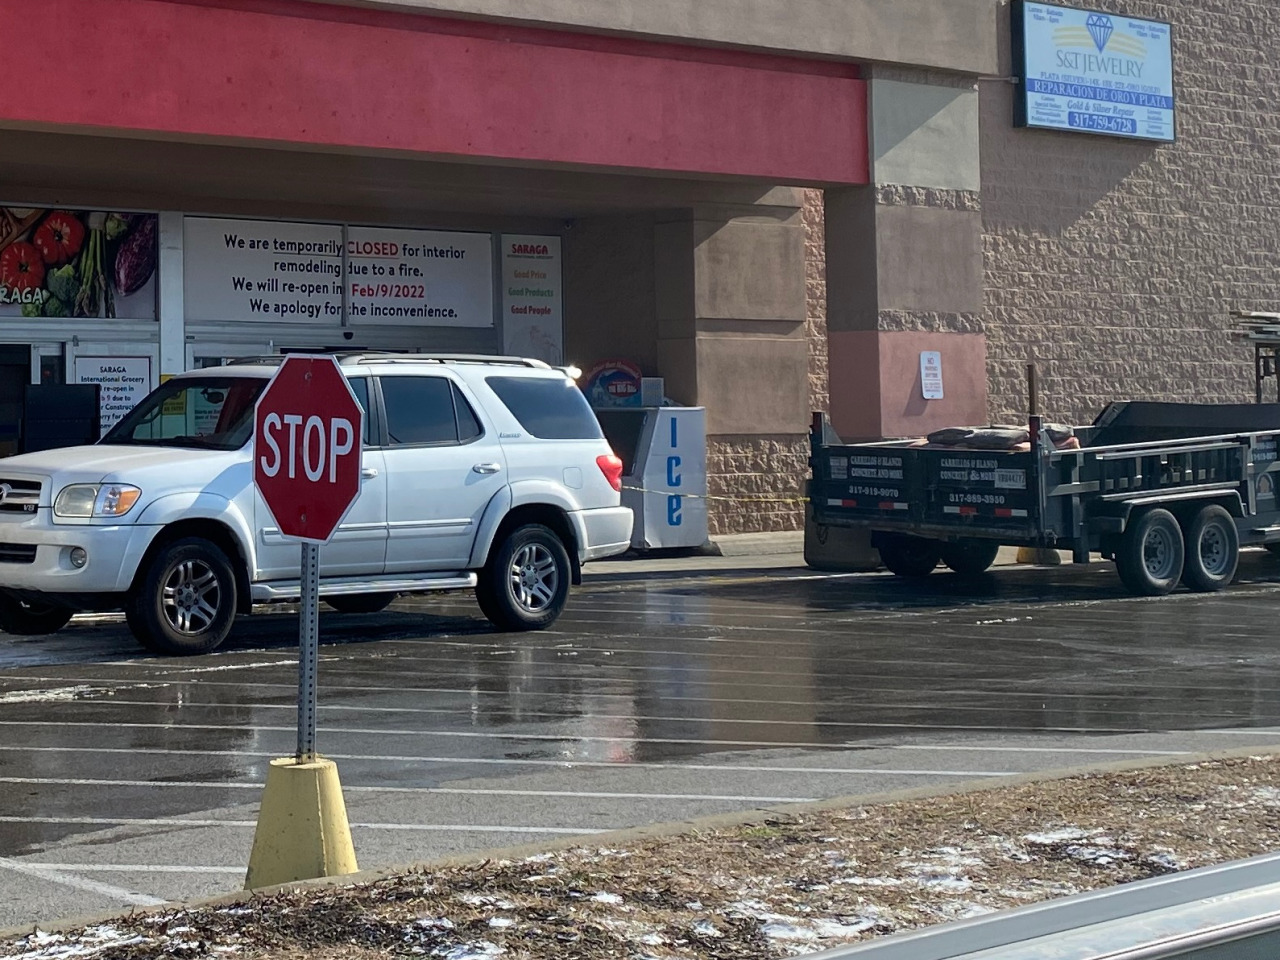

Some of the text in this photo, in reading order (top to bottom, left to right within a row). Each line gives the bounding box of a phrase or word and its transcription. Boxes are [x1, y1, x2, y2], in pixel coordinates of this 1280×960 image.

[1056, 49, 1144, 79] S&T JEWELRY
[1034, 80, 1167, 108] REPARACION DE ORO Y PLATA
[1073, 113, 1133, 133] 317-759-6728
[224, 234, 466, 259] We are temporarily CLOSED for interior
[511, 243, 548, 255] SARAGA
[274, 259, 424, 277] remodeling due to a fire.
[232, 277, 425, 298] We will re-open in Feb/9/2022
[525, 287, 554, 297] Products
[250, 298, 270, 313] We
[274, 300, 321, 318] apology
[324, 302, 341, 315] for
[371, 303, 458, 318] inconvenience.
[511, 305, 551, 317] Good People
[121, 376, 145, 384] Grocery
[261, 412, 354, 483] STOP
[851, 468, 877, 478] CONCRETE
[878, 469, 889, 478] AND
[940, 471, 969, 480] CONCRETE
[970, 470, 980, 481] &
[23, 504, 35, 512] V8
